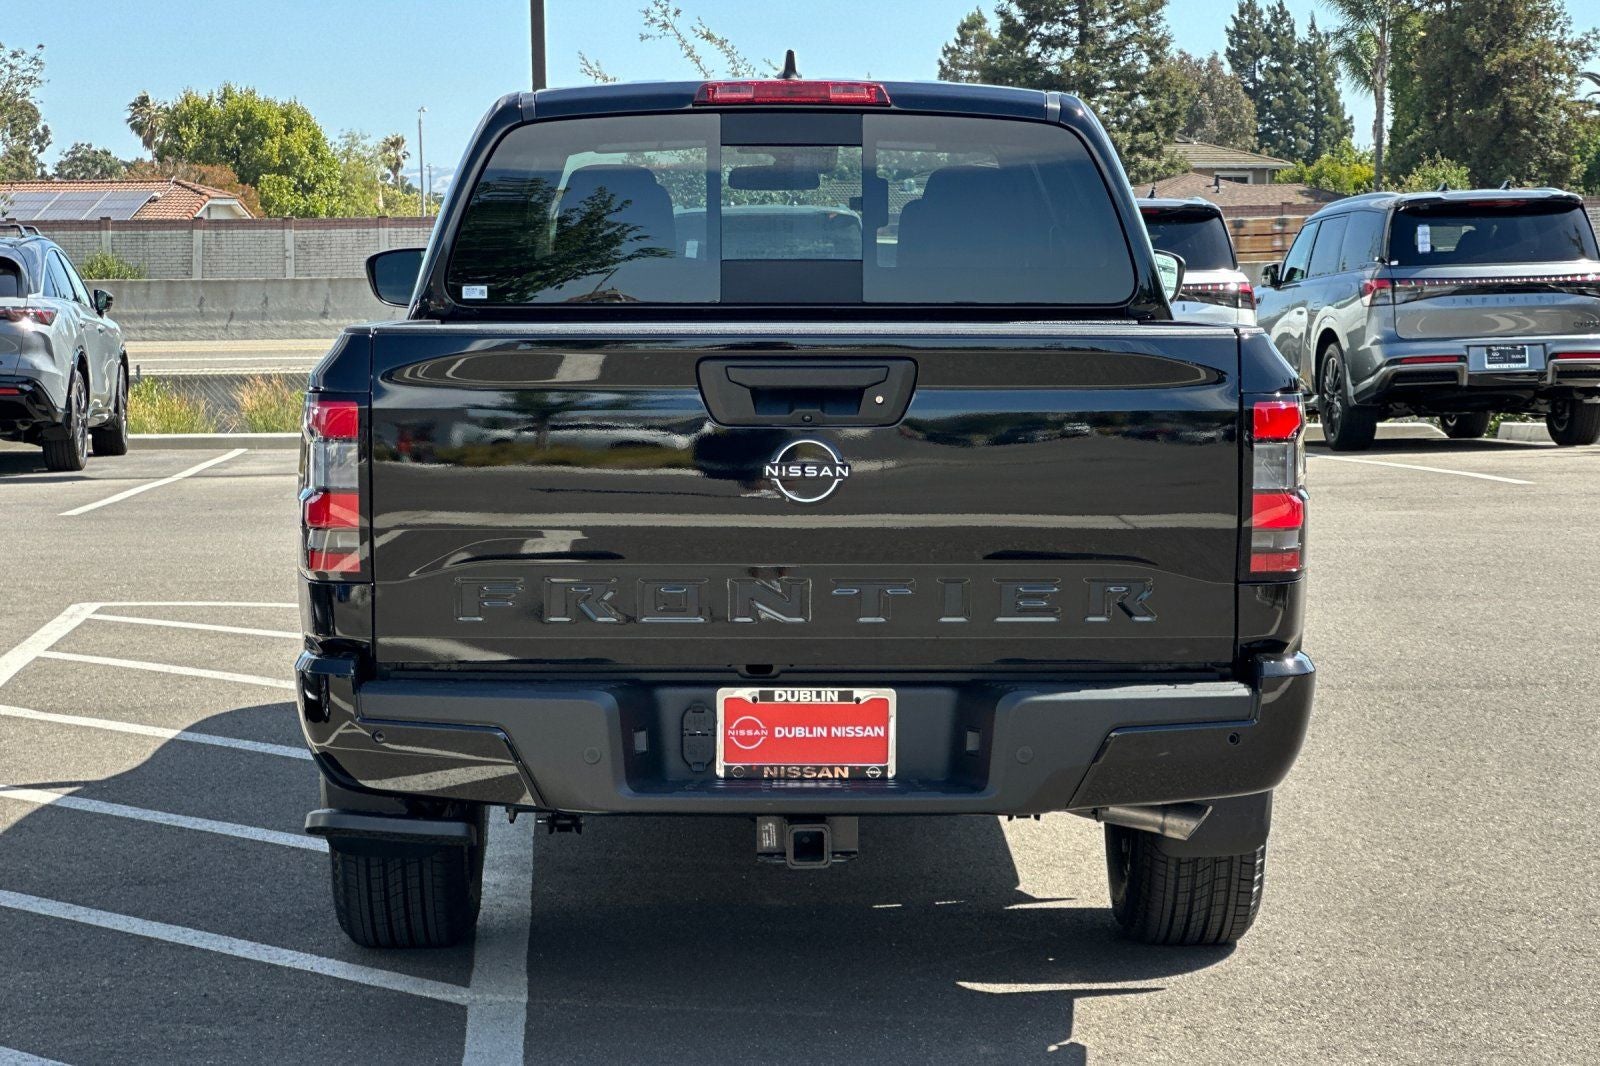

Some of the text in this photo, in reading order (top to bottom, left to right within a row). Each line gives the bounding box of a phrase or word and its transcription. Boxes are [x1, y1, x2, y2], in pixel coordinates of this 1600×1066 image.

[1452, 294, 1555, 305] INFINITI
[765, 465, 849, 477] NISSAN
[453, 577, 1157, 623] FRONTIER
[773, 690, 839, 702] DUBLIN
[728, 728, 768, 736] NISSAN
[774, 726, 885, 738] DUBLIN NISSAN
[763, 766, 849, 779] NISSAN
